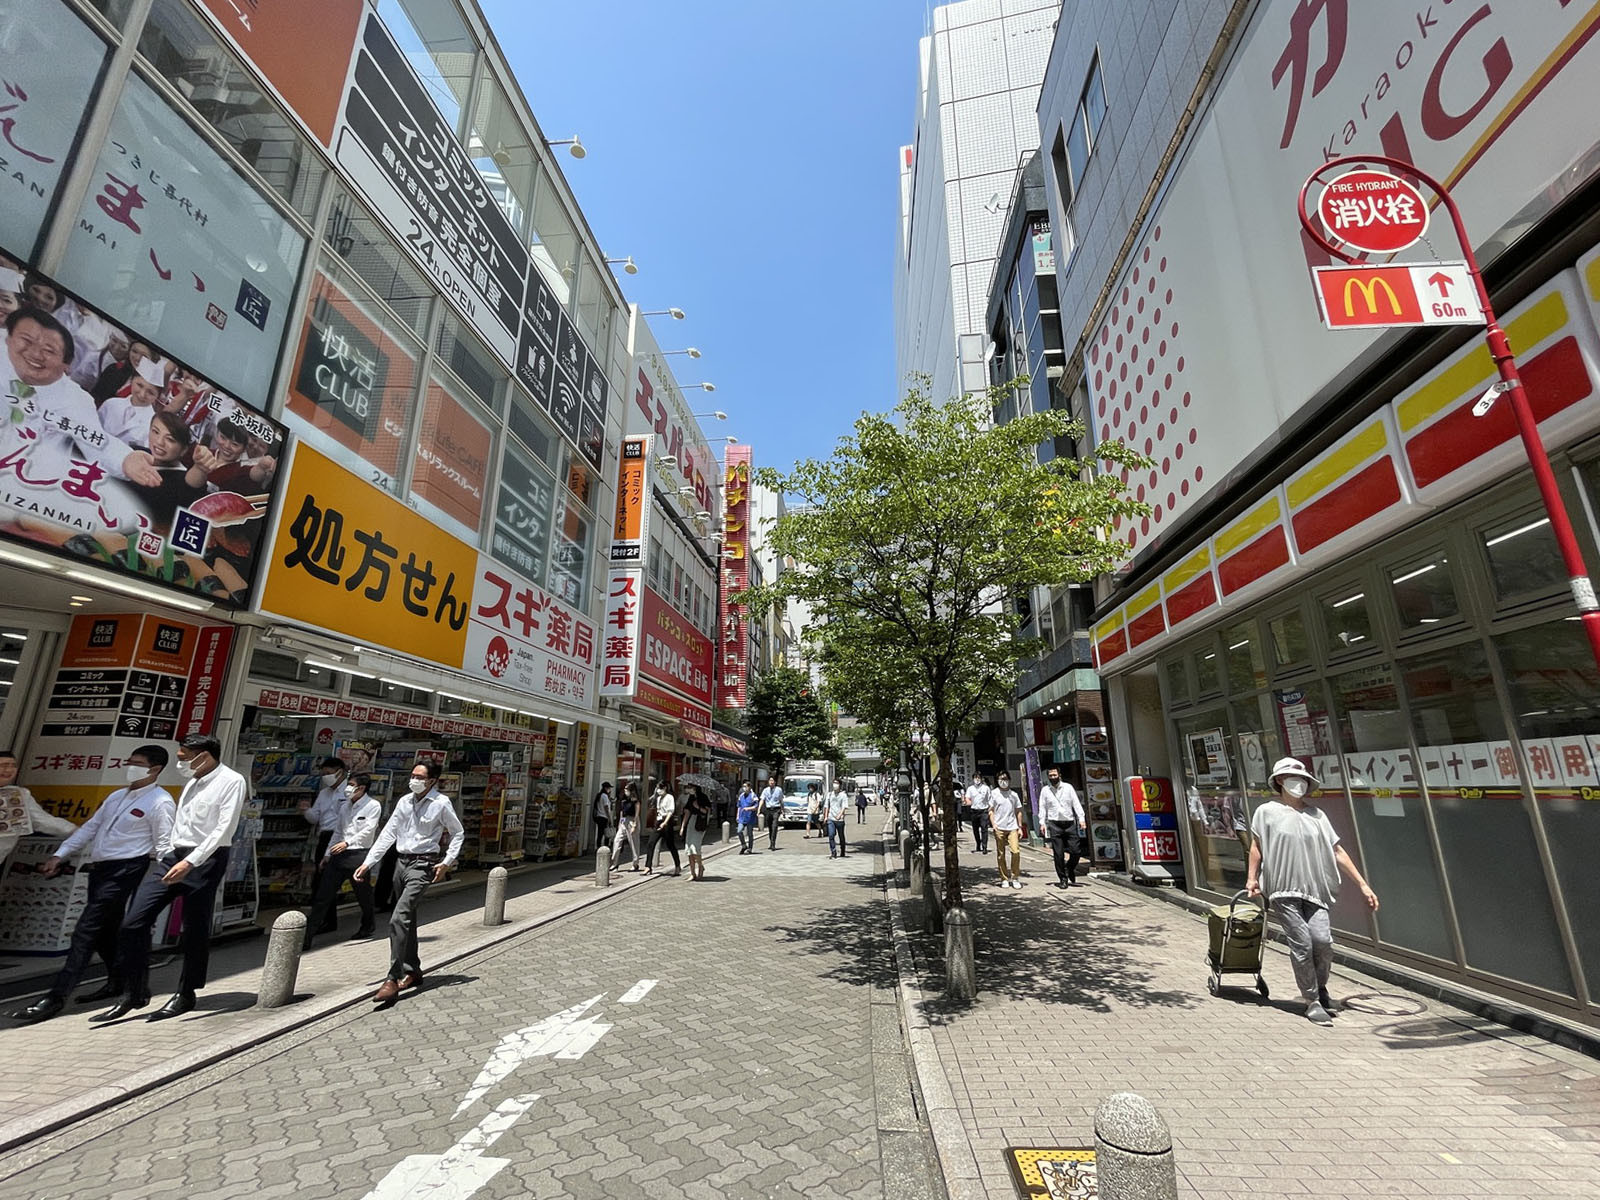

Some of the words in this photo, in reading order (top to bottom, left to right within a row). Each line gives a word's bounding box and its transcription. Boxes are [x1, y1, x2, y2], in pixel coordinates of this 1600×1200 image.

[431, 121, 488, 209] コミック
[397, 120, 501, 269] インターネット
[1331, 183, 1354, 194] FIRE
[1355, 180, 1400, 192] HYDRANT
[1327, 193, 1421, 229] 消火栓
[441, 269, 477, 319] OPEN
[1431, 302, 1467, 318] 60m
[315, 362, 369, 418] CLUB
[4, 393, 105, 447] つきじ喜代村
[230, 408, 274, 443] 赤坂店
[618, 471, 630, 534] インターネット
[631, 470, 642, 505] コミック
[284, 494, 468, 632] 処方せん
[476, 570, 594, 666] スギ薬局
[603, 576, 637, 688] スギ薬局
[79, 672, 105, 680] コミック
[546, 659, 587, 687] PHARMACY
[645, 632, 693, 686] ESPACE
[281, 696, 299, 709] 免税
[319, 702, 335, 714] 免税
[31, 753, 104, 770] スギ薬局
[1141, 800, 1166, 809] Daily
[1143, 835, 1177, 857] たばこ
